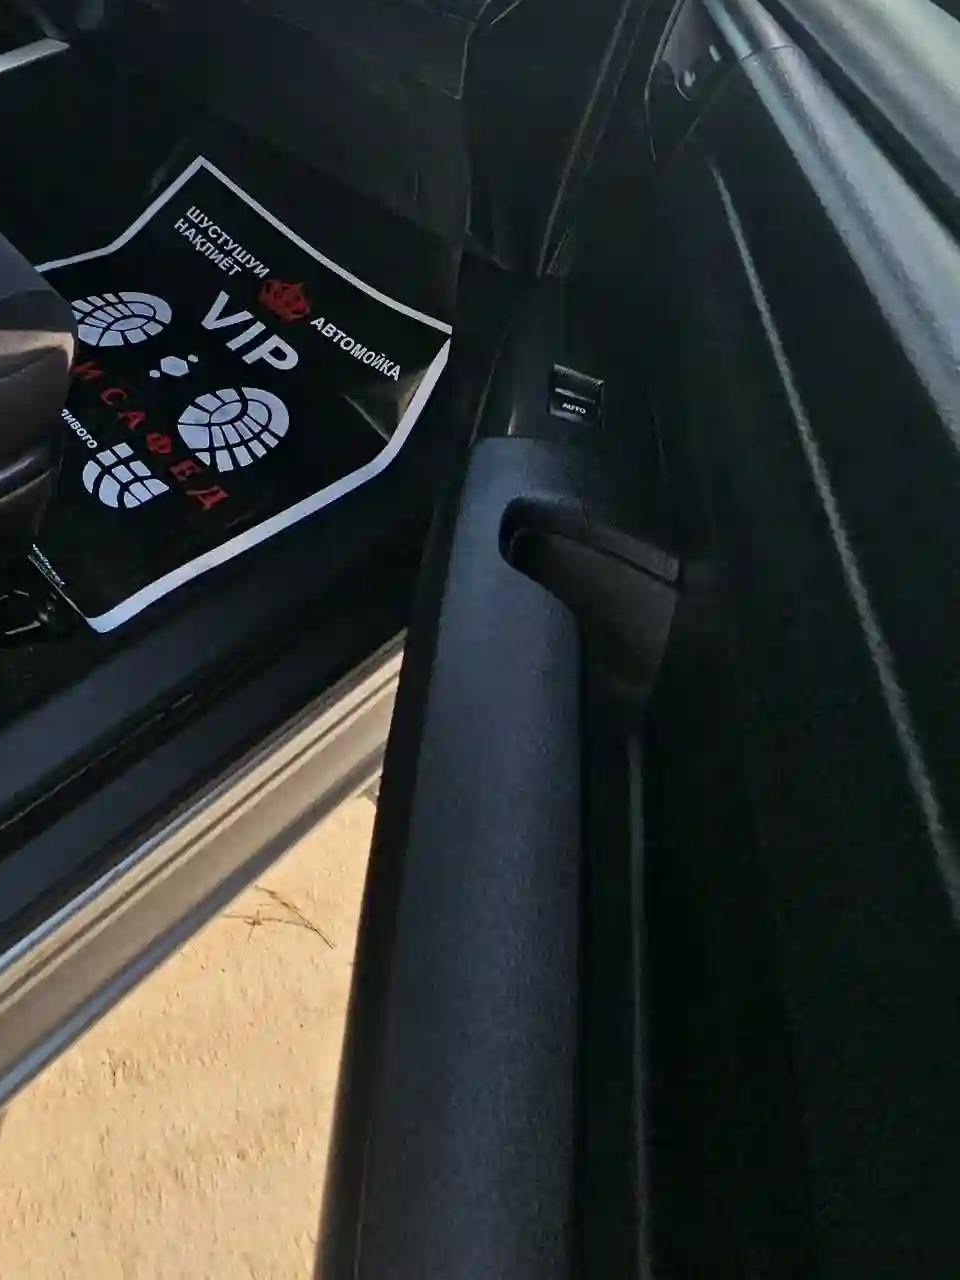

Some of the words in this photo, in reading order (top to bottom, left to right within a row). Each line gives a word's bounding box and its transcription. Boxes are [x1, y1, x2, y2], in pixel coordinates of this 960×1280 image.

[201, 290, 299, 370] VIP
[310, 317, 401, 381] АВТОМОЙКА
[562, 402, 587, 414] AUTO
